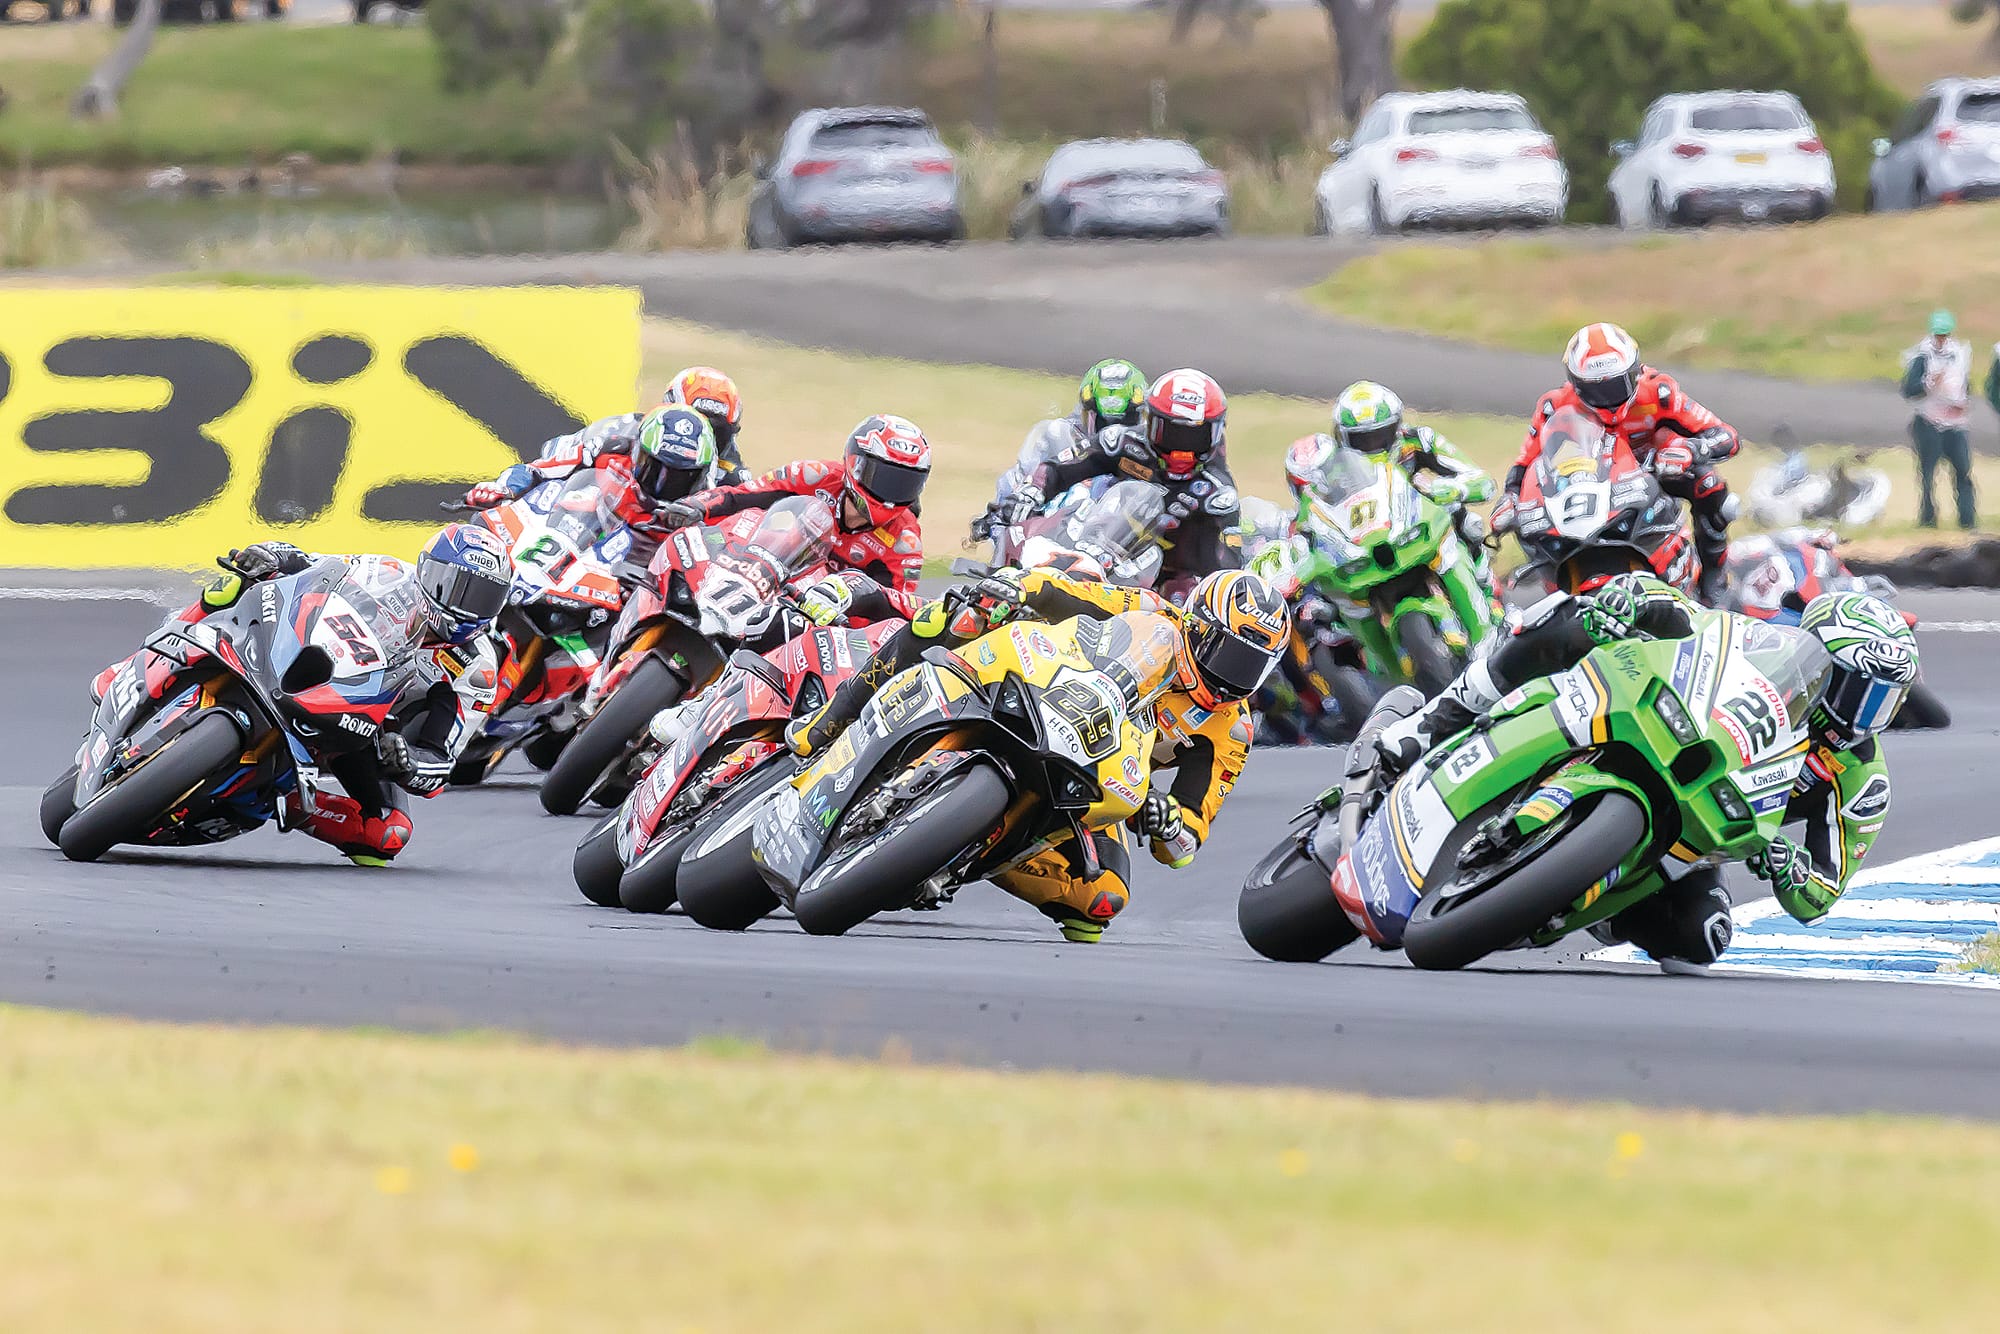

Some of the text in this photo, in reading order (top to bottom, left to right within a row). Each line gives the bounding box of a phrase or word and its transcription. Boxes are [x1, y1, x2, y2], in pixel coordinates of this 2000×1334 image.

[1563, 492, 1598, 524] 9
[448, 562, 468, 572] GIVES
[471, 569, 486, 578] YOU
[468, 553, 494, 569] SHOEI
[516, 535, 577, 586] 21
[1239, 602, 1284, 630] NOLAN
[323, 613, 380, 667] 54
[816, 630, 833, 672] Lenovo
[1040, 678, 1117, 759] 29
[1048, 717, 1079, 754] HERO
[1721, 690, 1777, 756] 22
[1718, 715, 1750, 760] MOTUL
[1104, 777, 1144, 804] VIGNALI
[1751, 766, 1788, 788] Kawasaki
